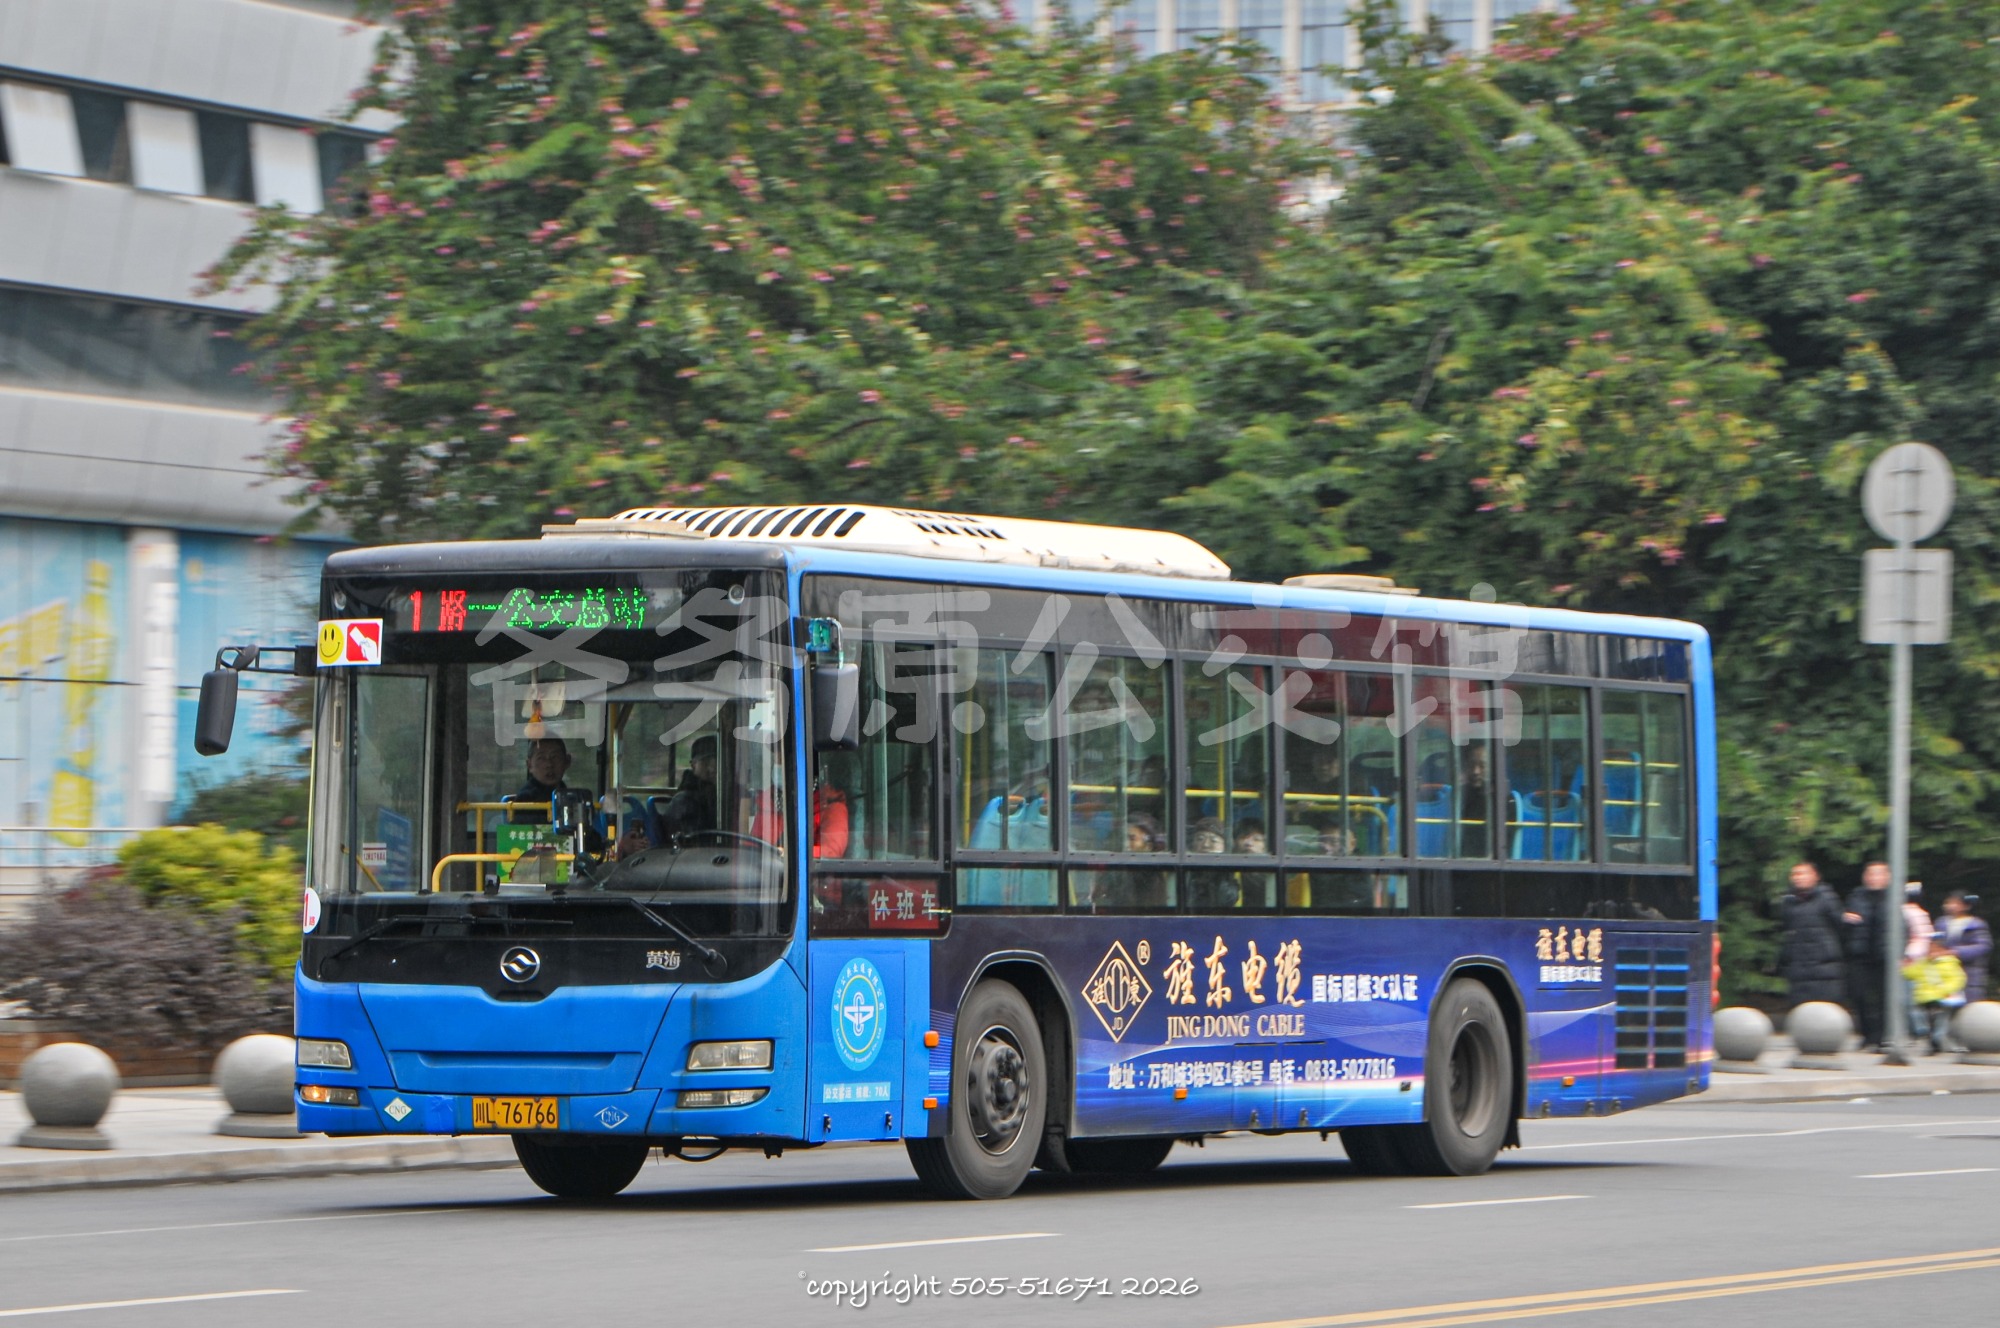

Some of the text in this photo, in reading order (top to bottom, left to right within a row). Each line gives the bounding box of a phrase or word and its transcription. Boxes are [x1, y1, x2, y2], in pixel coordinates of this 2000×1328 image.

[410, 590, 467, 632] 1路
[872, 889, 936, 921] 休班车
[646, 950, 681, 970] 黄海
[1165, 1014, 1306, 1045] JING DONG CABLE
[388, 1105, 407, 1115] CNG
[601, 1108, 620, 1122] CNG
